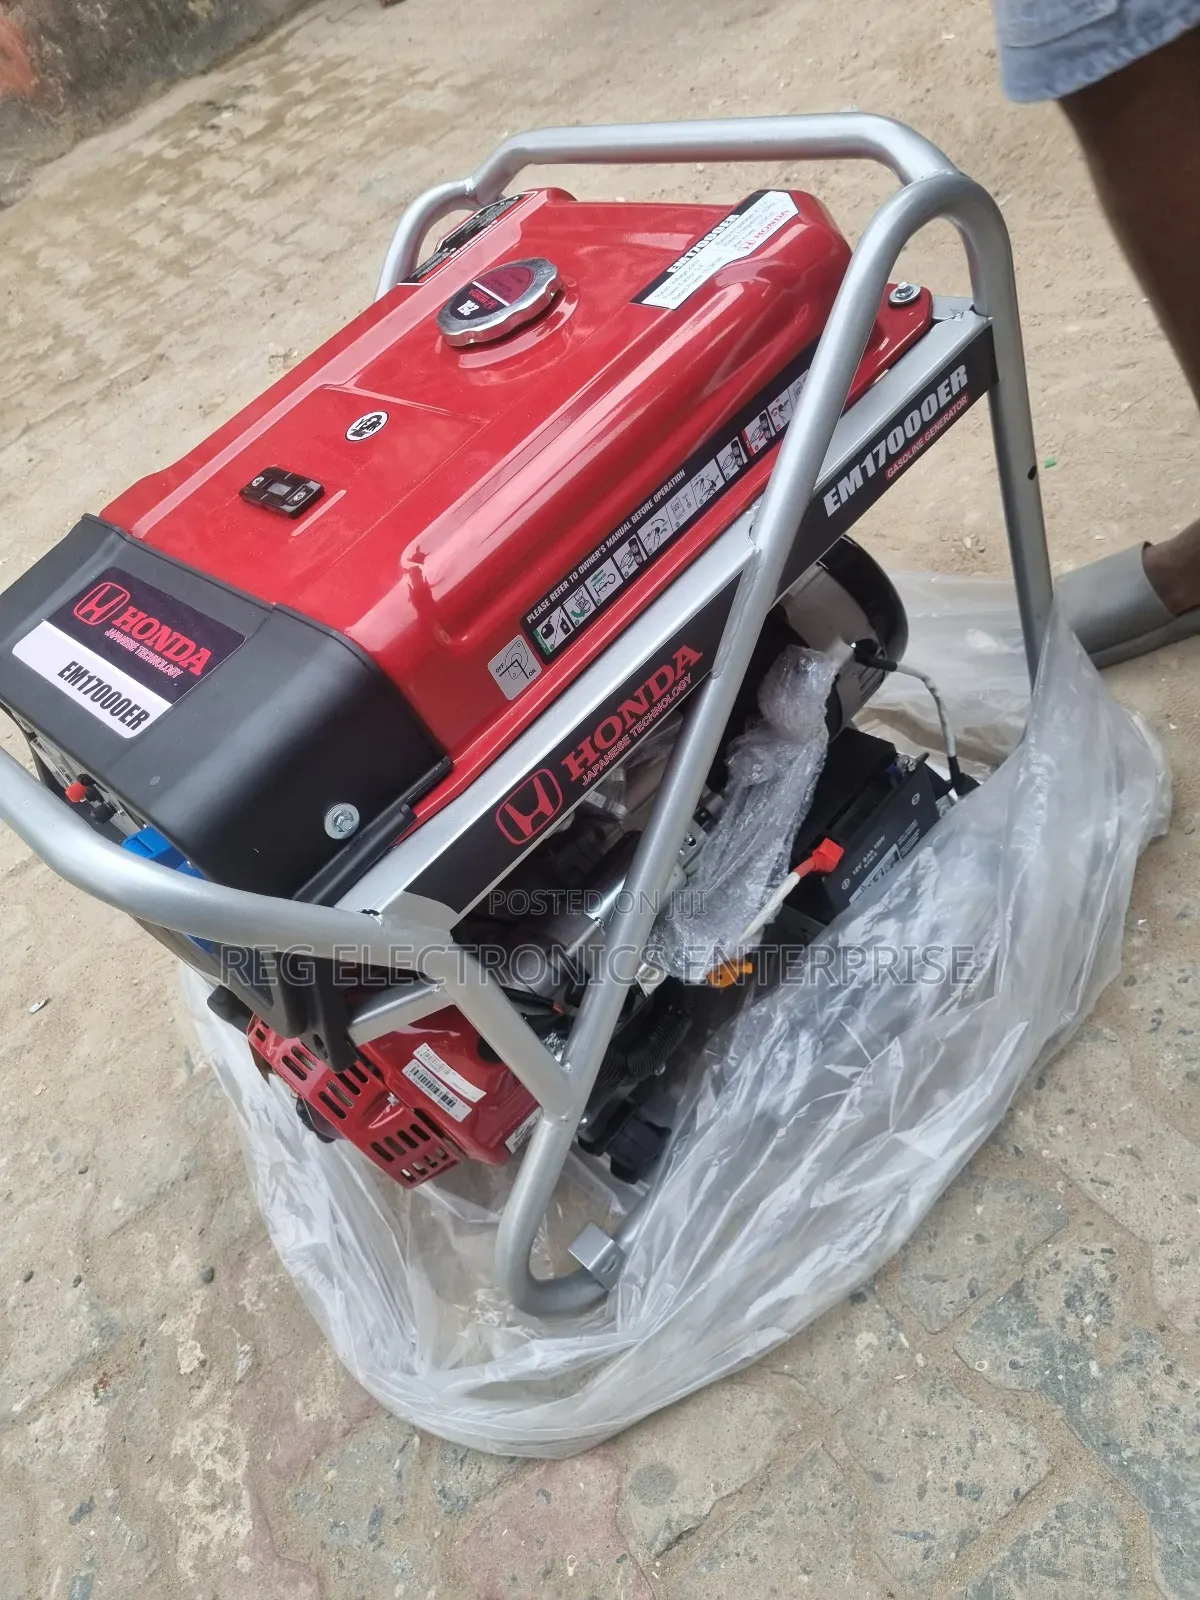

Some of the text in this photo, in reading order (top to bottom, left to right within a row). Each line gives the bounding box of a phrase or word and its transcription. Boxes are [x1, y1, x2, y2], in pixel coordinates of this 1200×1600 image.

[823, 364, 970, 517] EM17000ER
[887, 395, 970, 479] GASOLINE GENERATOR
[526, 469, 686, 624] PLEASE REFER TO OWNER'S MANUAL BEFORE OPERATION
[104, 628, 183, 679] JAPANESE TECHNOLOGY
[112, 605, 213, 676] HONDA
[495, 662, 504, 674] OFF
[528, 668, 537, 678] ON
[57, 660, 151, 730] EM17000ER
[560, 644, 704, 782] HONDA
[582, 673, 693, 787] JAPANESE TECHNOLOGY
